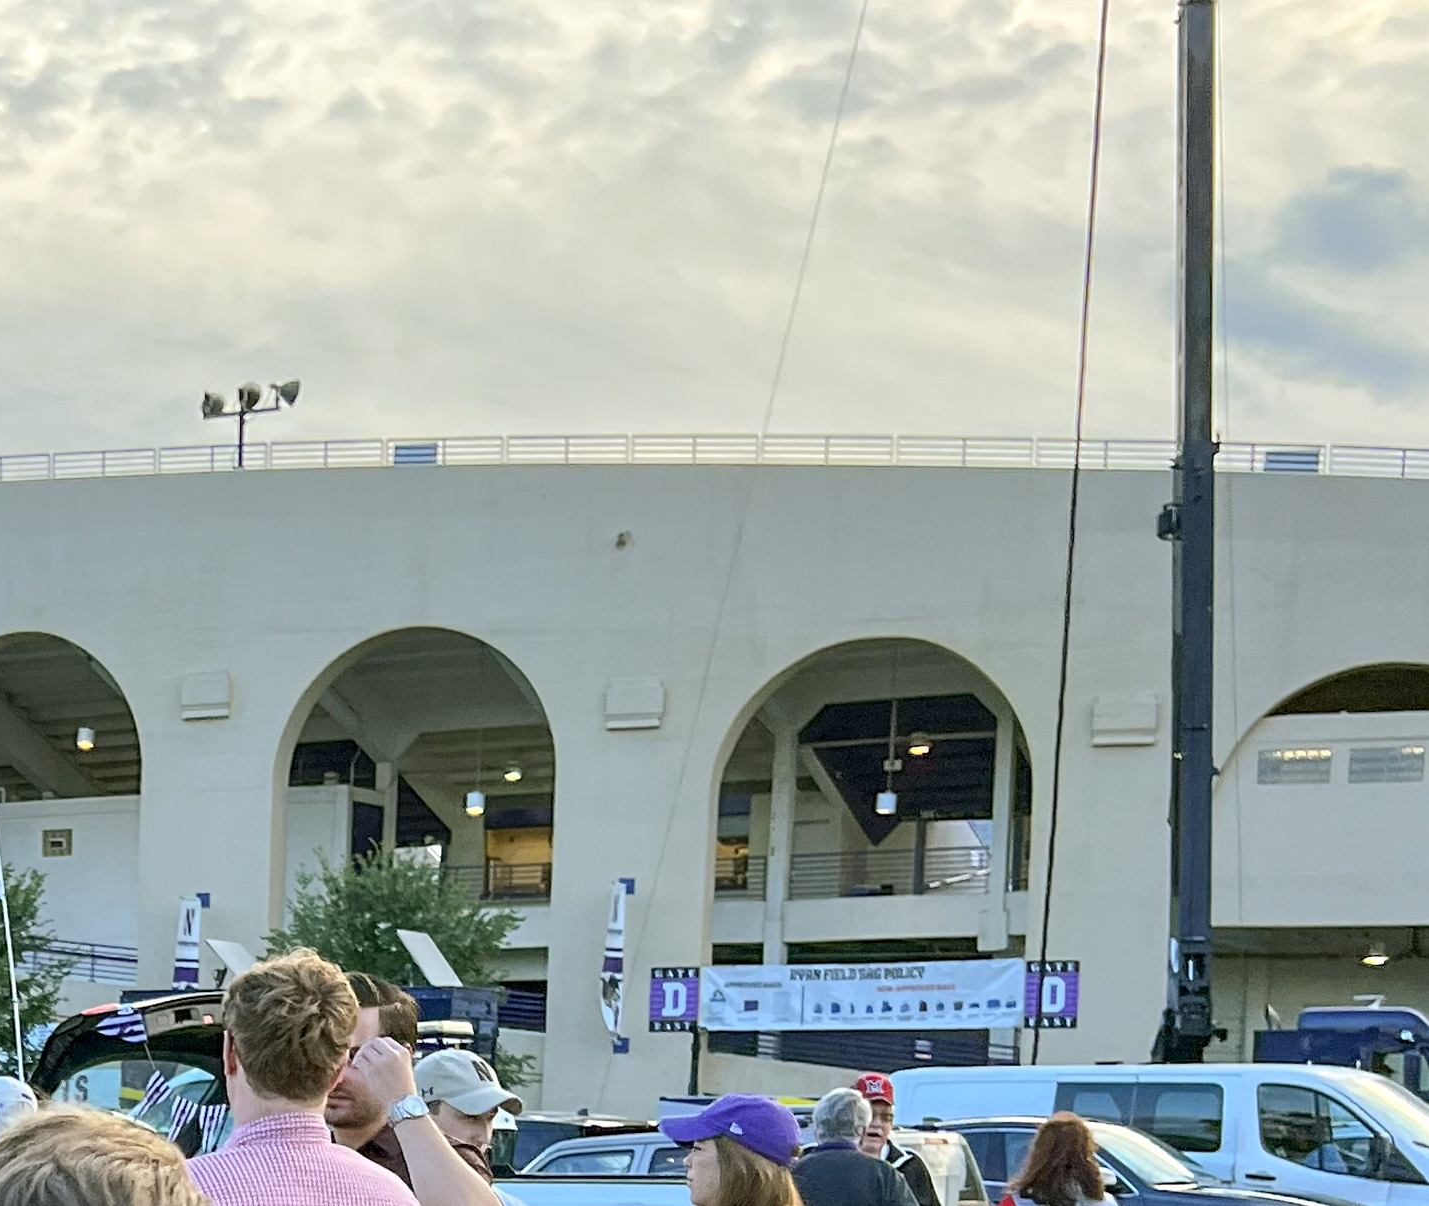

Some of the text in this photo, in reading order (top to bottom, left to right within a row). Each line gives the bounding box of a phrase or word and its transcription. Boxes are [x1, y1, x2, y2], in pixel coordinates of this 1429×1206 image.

[823, 968, 856, 980] FIELD
[884, 966, 925, 979] POLICY
[662, 982, 687, 1017] D
[1042, 976, 1066, 1013] D
